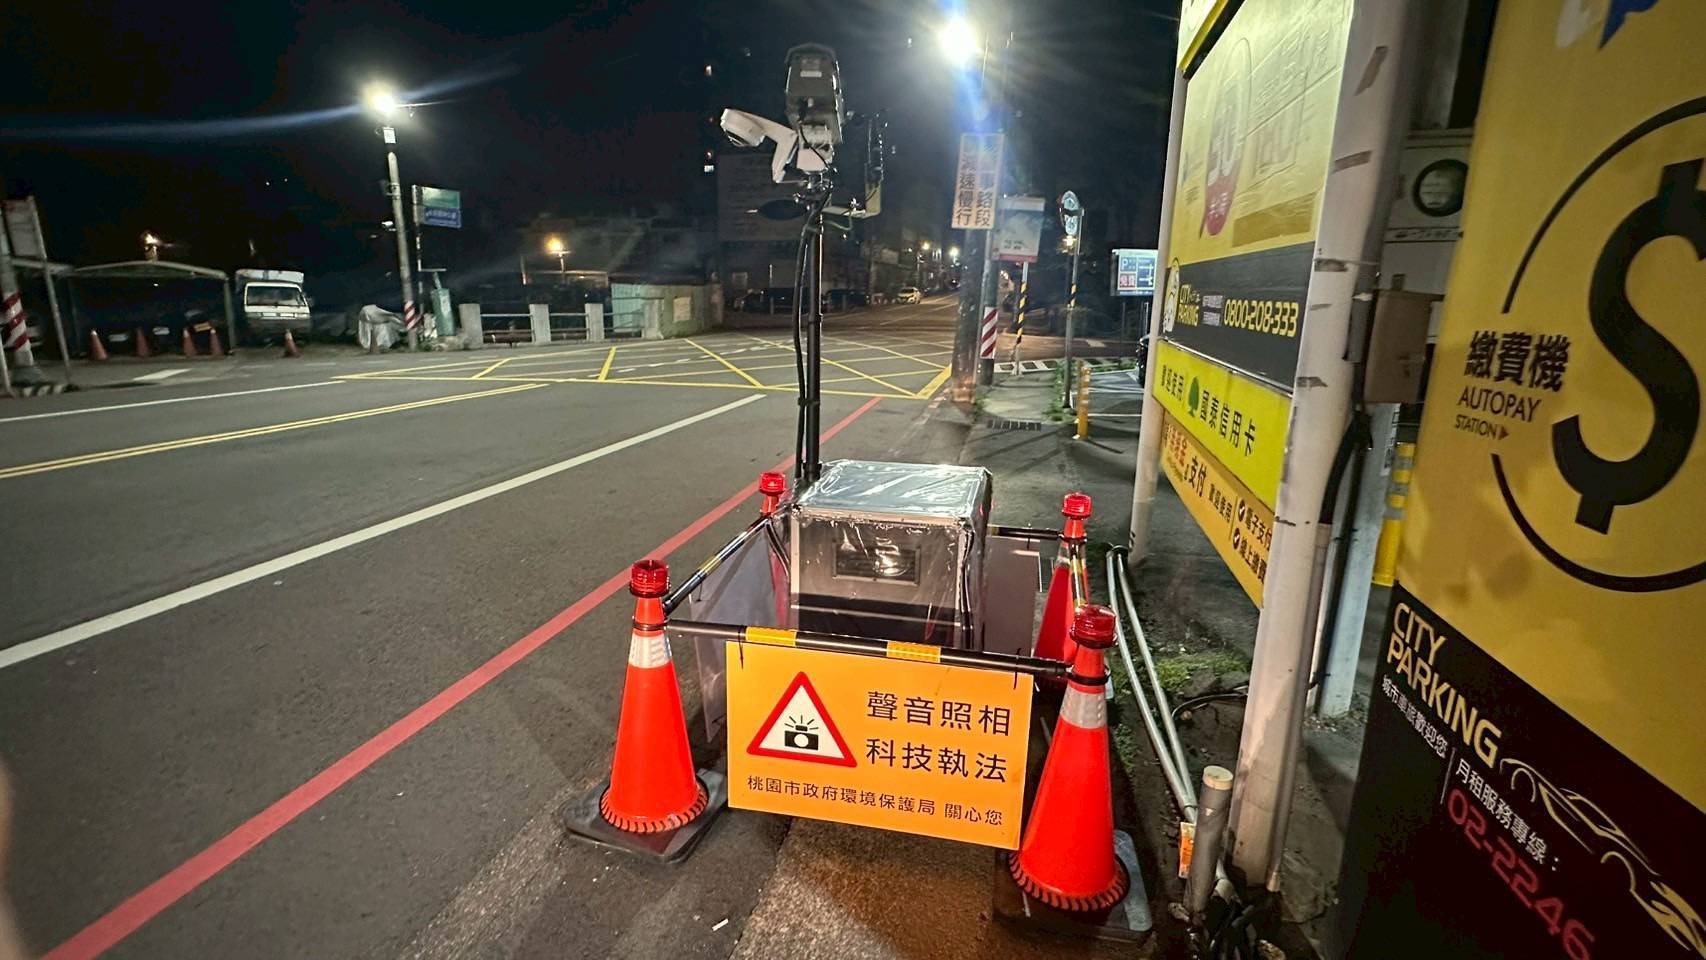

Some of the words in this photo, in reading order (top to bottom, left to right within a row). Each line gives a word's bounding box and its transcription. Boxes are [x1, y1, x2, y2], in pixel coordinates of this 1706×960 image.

[956, 137, 977, 226] 減速慢行
[1224, 298, 1299, 338] 0800-208-333
[1464, 329, 1571, 393] 繳費機
[1454, 414, 1498, 439] STATION
[1458, 386, 1542, 423] AUTOPAY
[1393, 602, 1446, 667] CITY
[866, 690, 1011, 737] 聲音照相
[1387, 636, 1502, 769] PARKING
[866, 737, 1008, 783] 科技執法
[747, 775, 936, 816] 桃園市政府環境保護局
[944, 803, 1003, 826] 關心您
